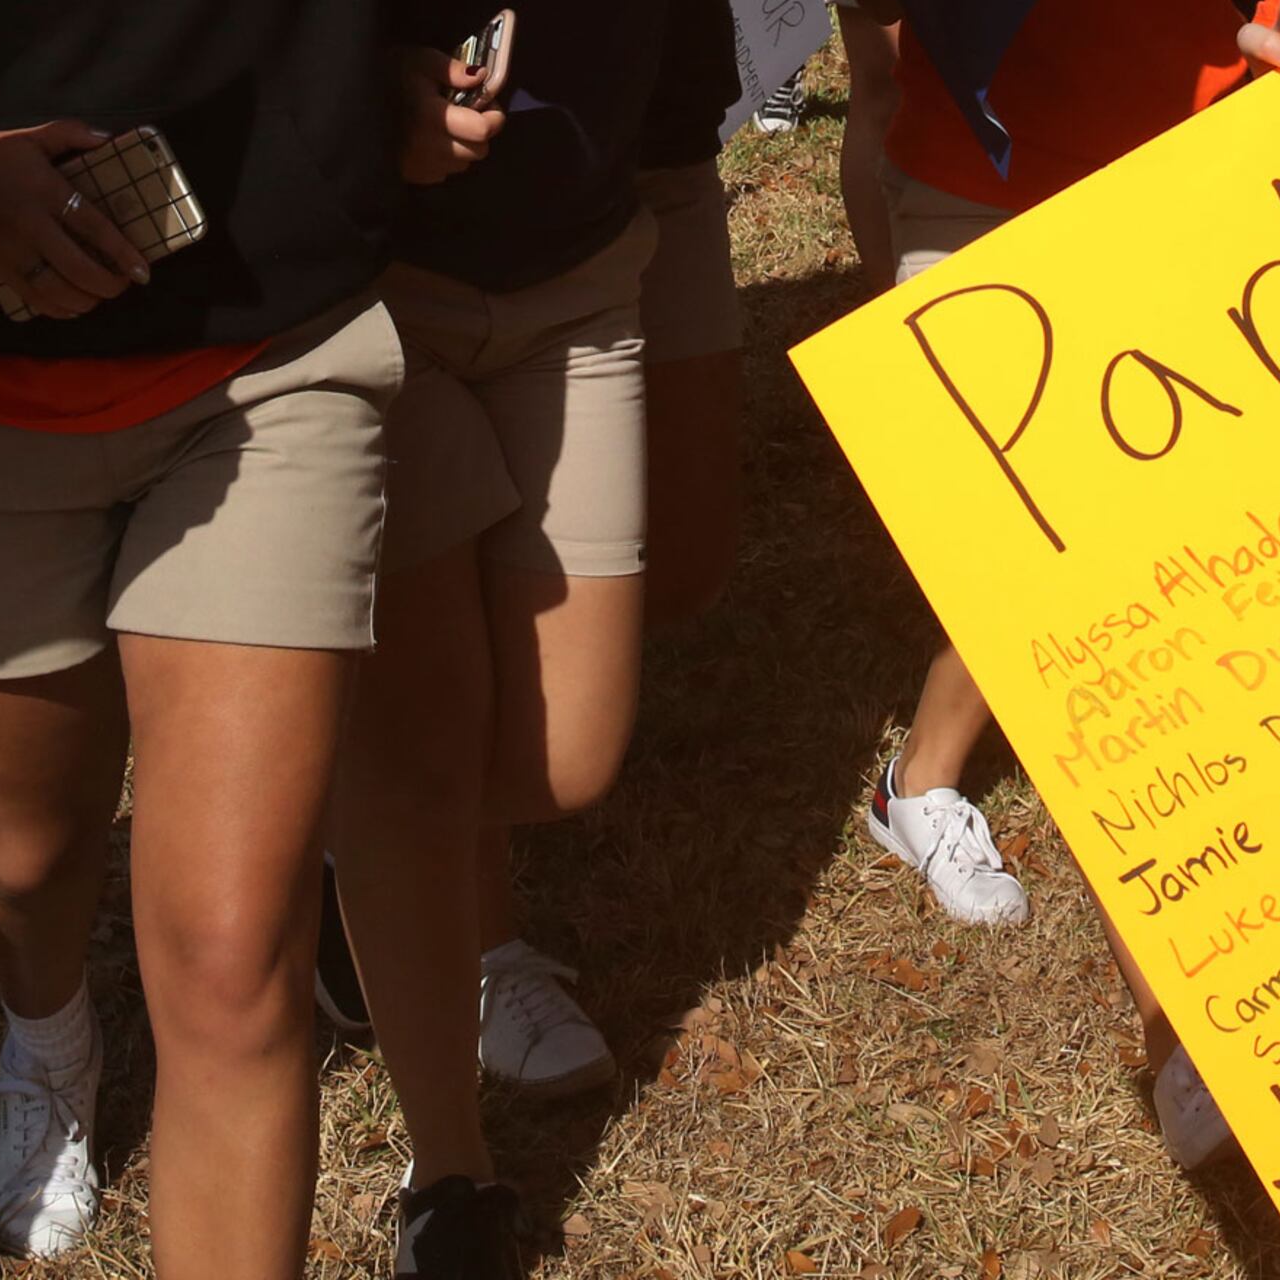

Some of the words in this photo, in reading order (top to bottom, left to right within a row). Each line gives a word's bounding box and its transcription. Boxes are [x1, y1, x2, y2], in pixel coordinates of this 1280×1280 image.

[1031, 602, 1160, 689] Alyssa
[1067, 627, 1206, 739] Aaron
[1055, 687, 1204, 787] Martin
[1091, 752, 1248, 855] Nichlos
[1119, 821, 1263, 915] Jamie
